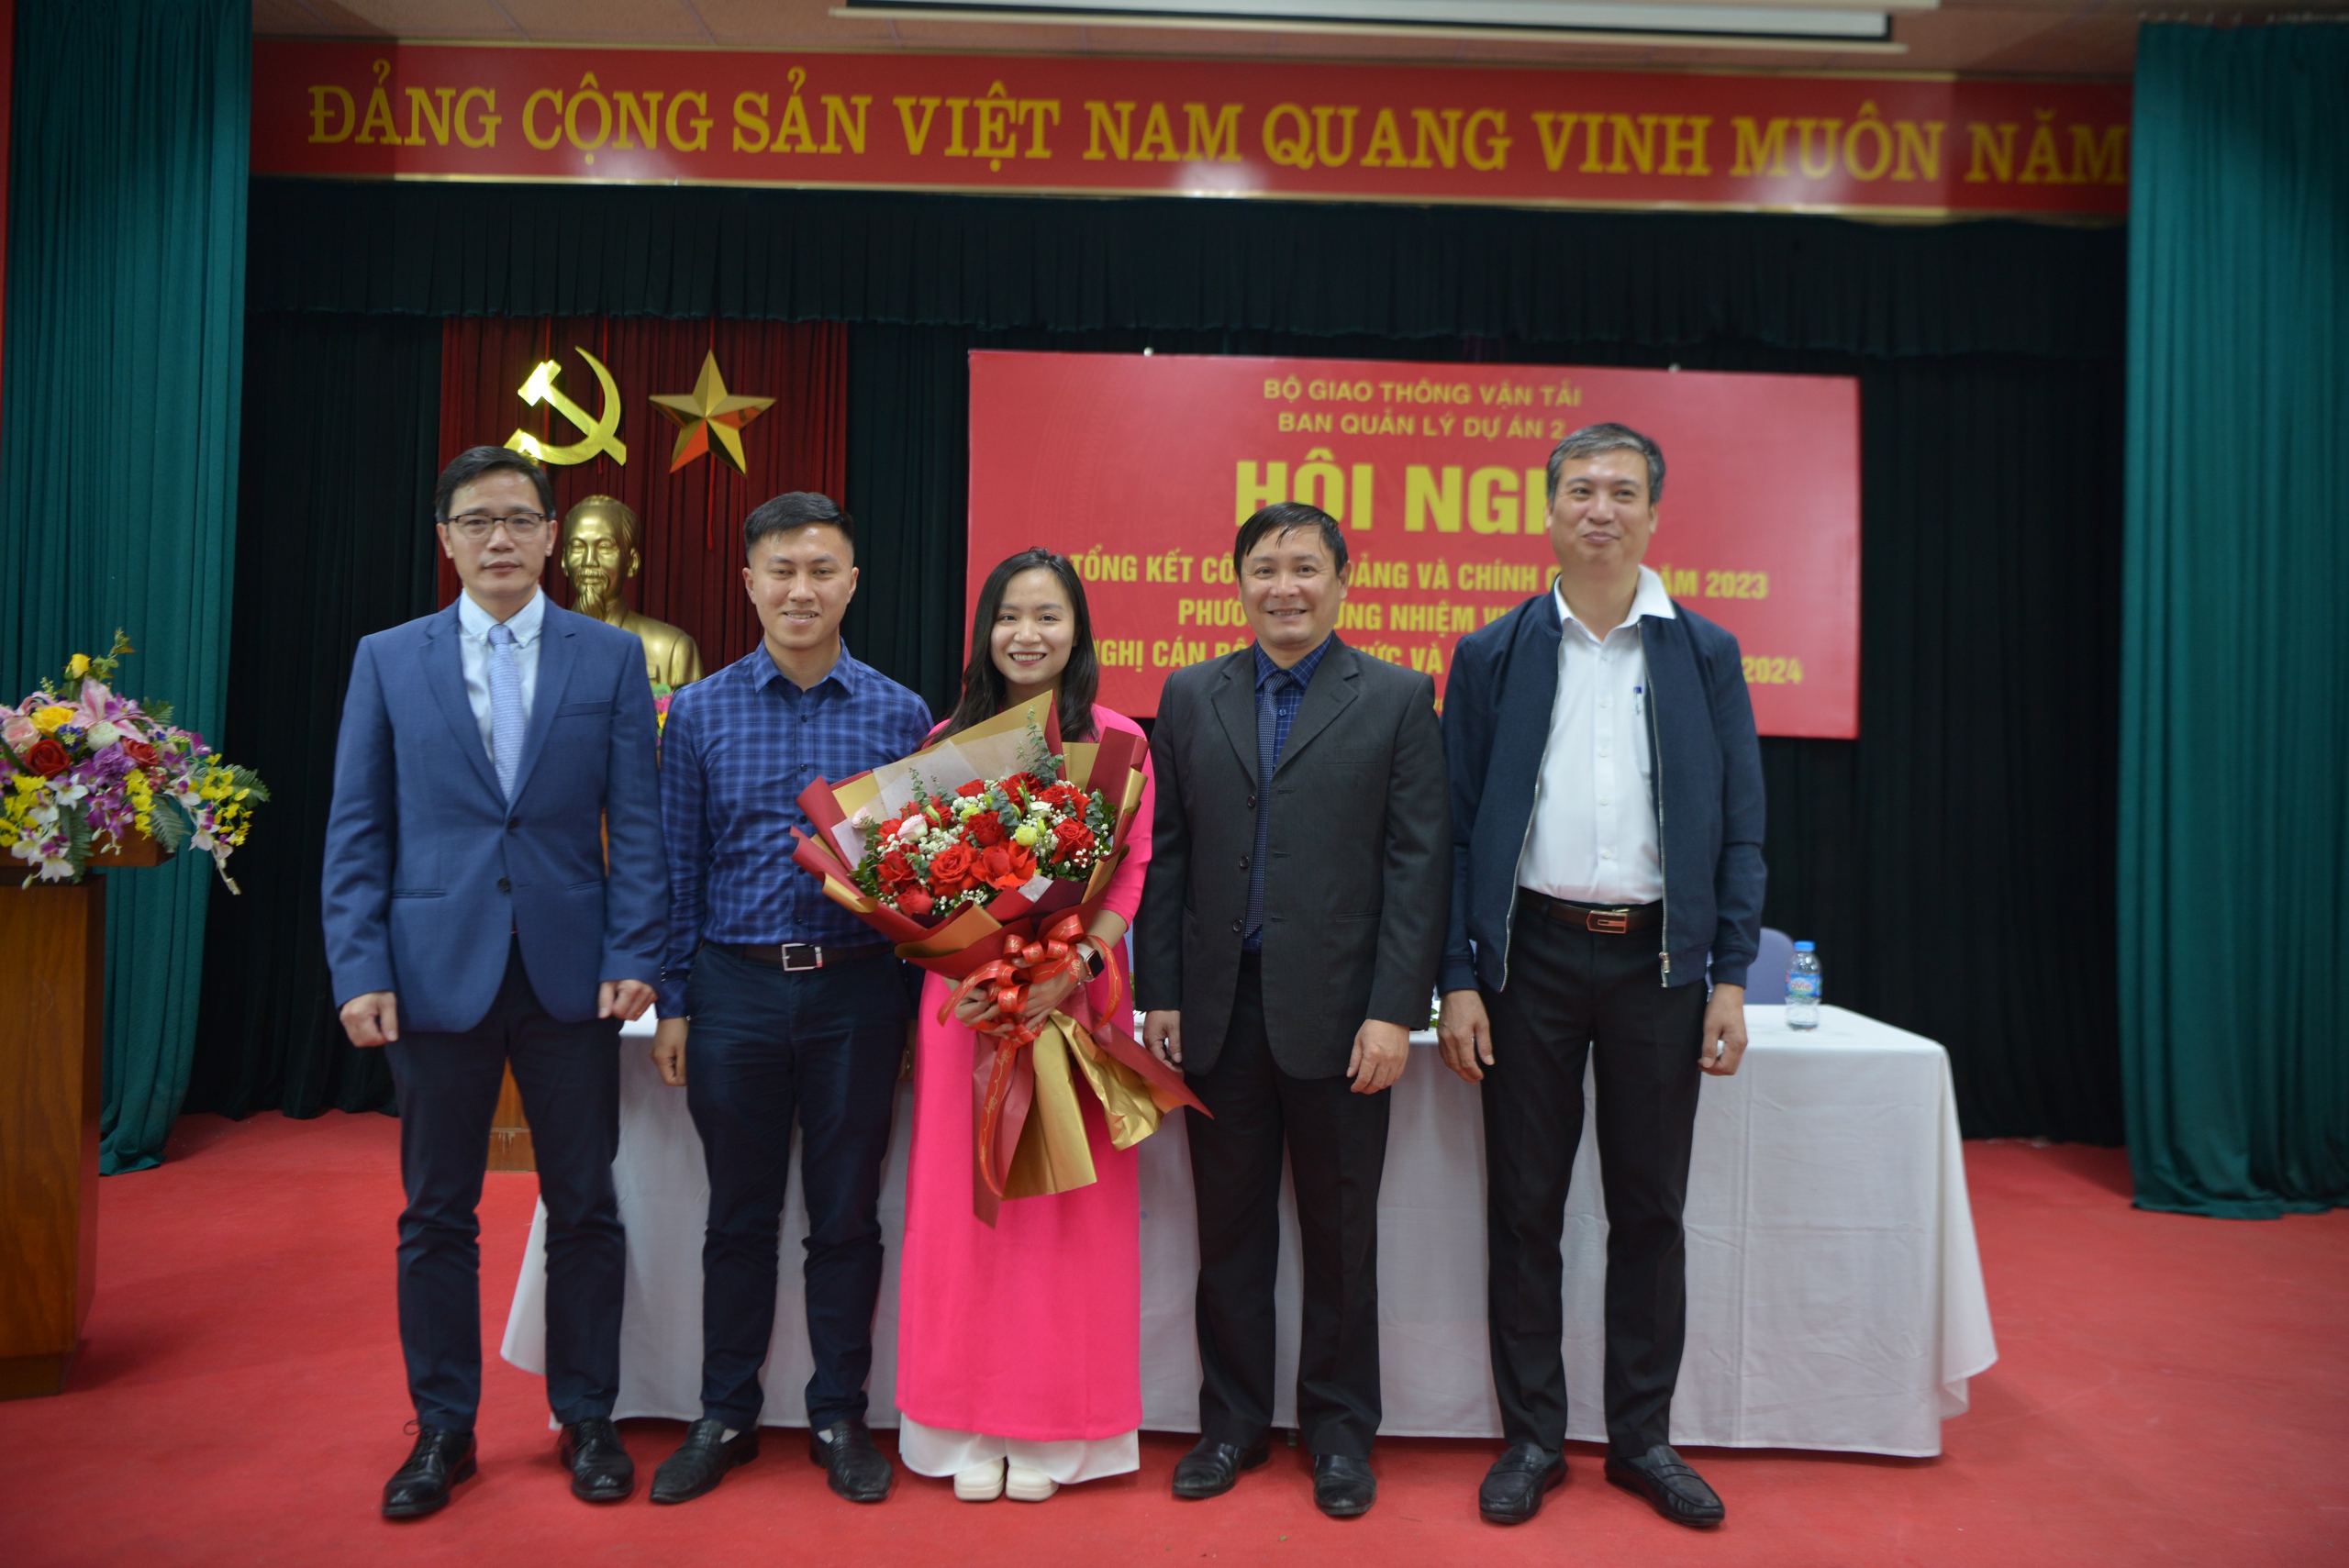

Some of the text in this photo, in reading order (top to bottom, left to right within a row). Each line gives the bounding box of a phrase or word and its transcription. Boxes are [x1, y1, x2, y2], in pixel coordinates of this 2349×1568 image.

[308, 59, 2128, 183] ĐẢNG CỘNG SẢN VIỆT NAM QUANG VINH MUÔN NĂM
[1264, 375, 1583, 410] BỘ GIAO THÔNG VẬN TẢI
[1278, 407, 1565, 442] BAN QUẢN LÝ DỰ ÁN 2
[1404, 465, 1549, 535] NG
[1069, 543, 1138, 582] TỔNG
[1146, 547, 1194, 584] KẾT
[1416, 557, 1450, 590] VÀ
[1457, 559, 1539, 593] CHÍNH
[1660, 562, 1699, 597] ĂM
[1705, 570, 1770, 600] 2023
[1389, 600, 1476, 639] NHIỆM
[1152, 636, 1207, 668] CÁN
[1409, 641, 1443, 674] VÀ
[1741, 655, 1804, 685] 2024
